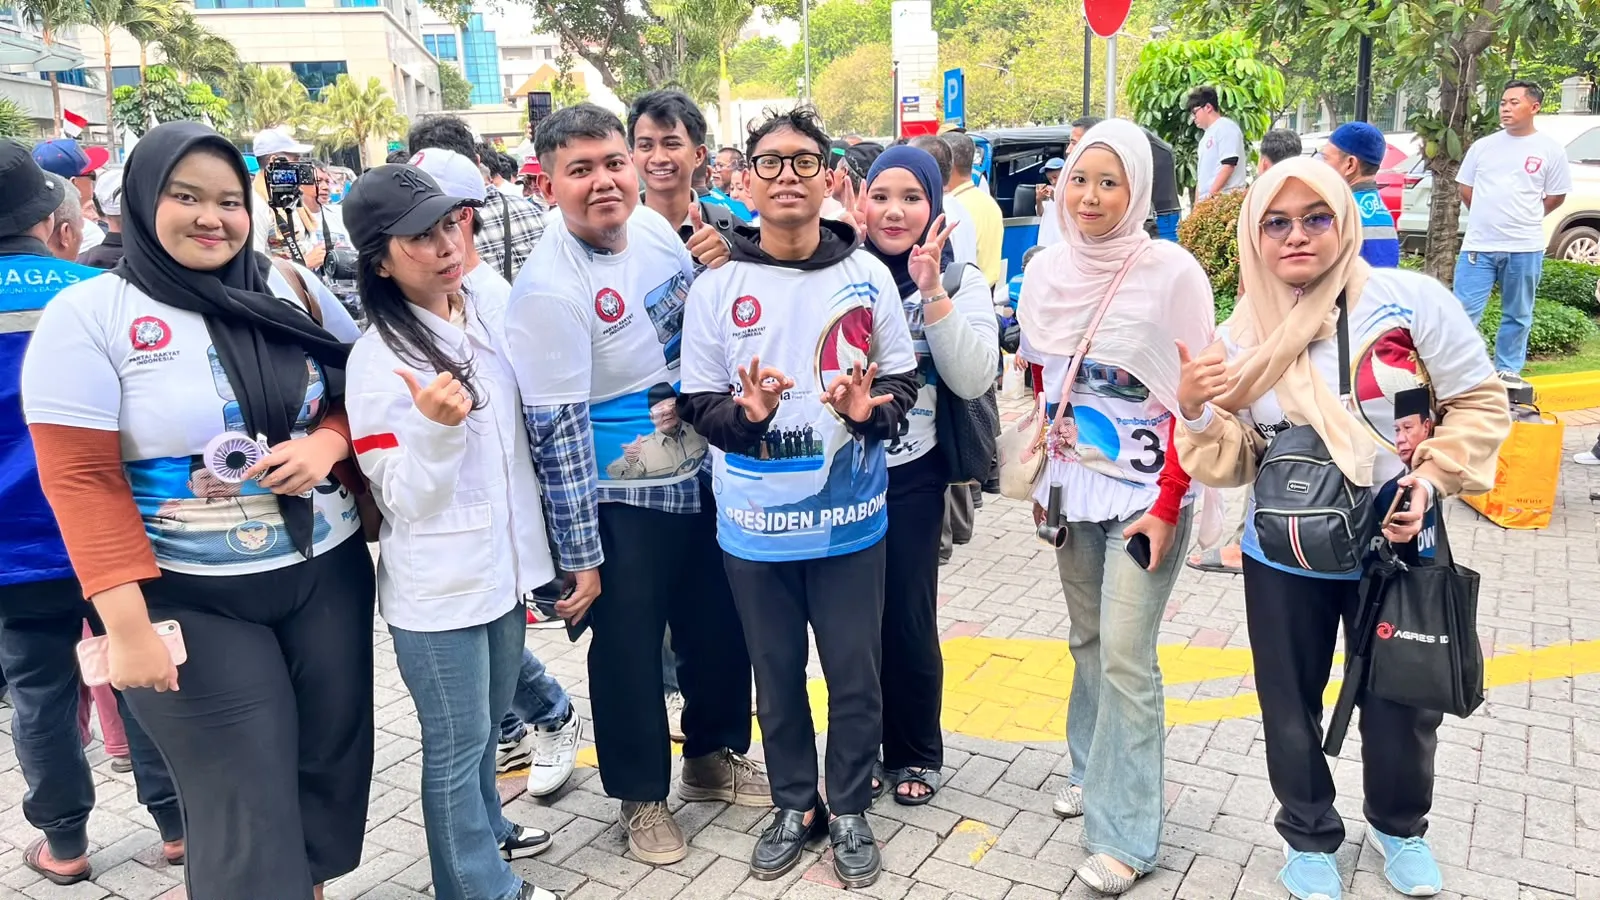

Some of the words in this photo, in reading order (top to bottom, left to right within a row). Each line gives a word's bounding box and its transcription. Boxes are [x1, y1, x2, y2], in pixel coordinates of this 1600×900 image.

[947, 78, 959, 113] P
[286, 236, 303, 260] SONY
[0, 268, 81, 286] AGAS
[128, 354, 152, 363] PARTAI
[153, 350, 180, 358] RAKYAT
[136, 356, 175, 366] INDONESIA
[1129, 428, 1166, 474] 3
[725, 506, 814, 532] PRESIDEN
[1393, 629, 1436, 644] AGRES
[1439, 635, 1449, 644] ID
